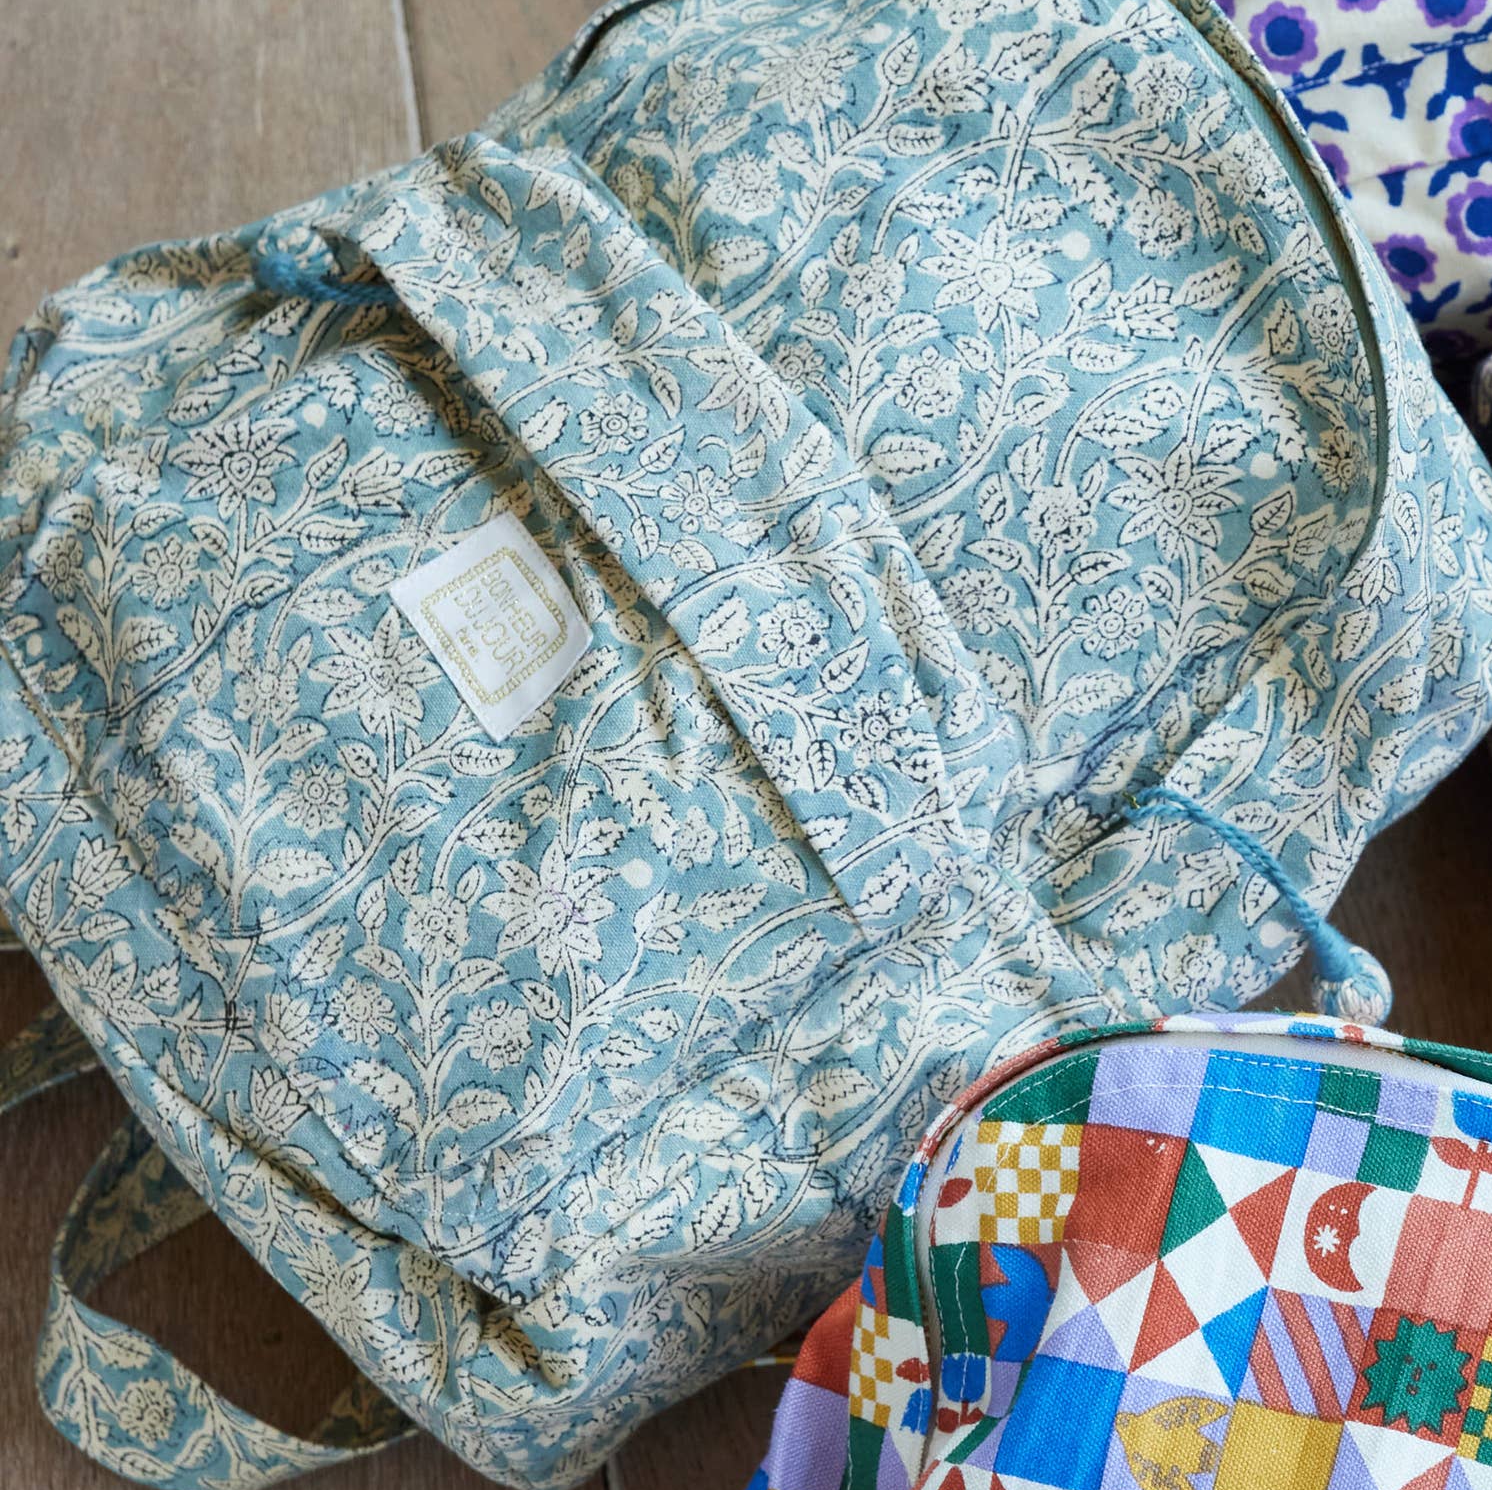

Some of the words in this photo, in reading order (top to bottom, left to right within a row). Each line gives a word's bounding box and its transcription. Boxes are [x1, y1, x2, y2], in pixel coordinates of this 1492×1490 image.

[454, 587, 489, 619] DU
[472, 616, 524, 675] JOUR
[480, 569, 547, 654] BONHEUR
